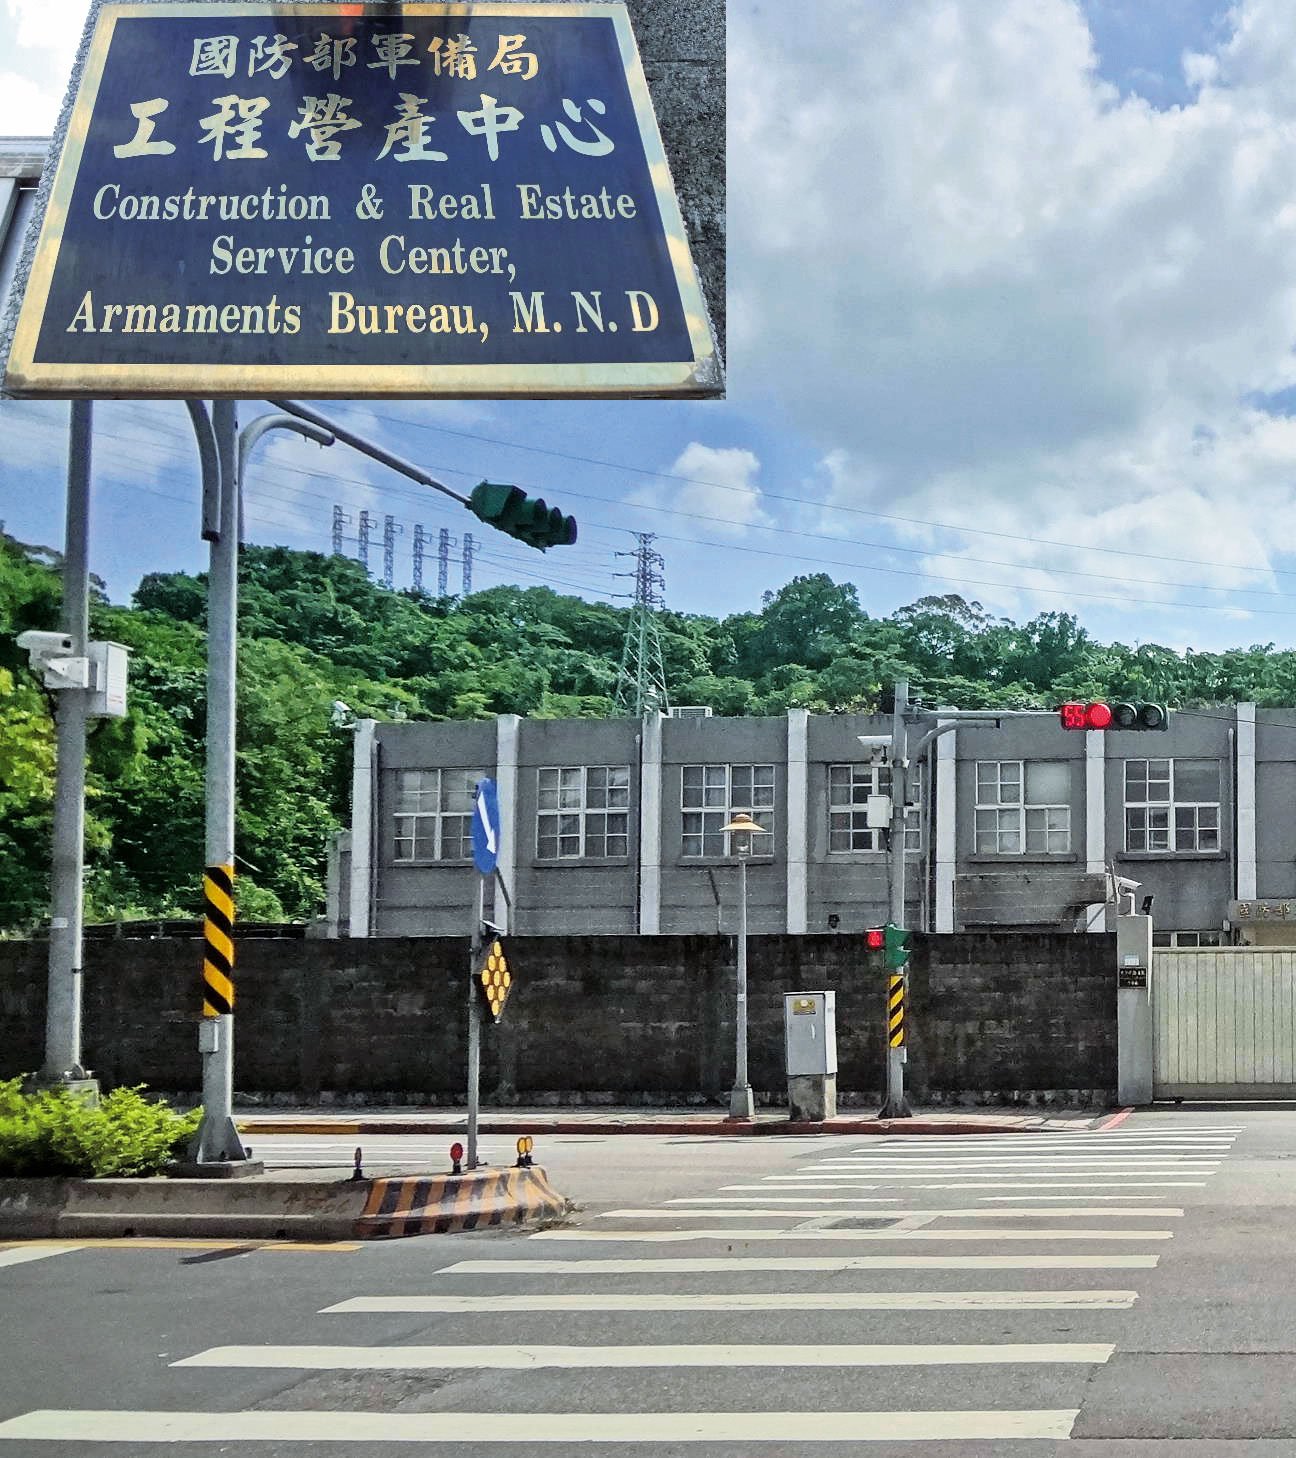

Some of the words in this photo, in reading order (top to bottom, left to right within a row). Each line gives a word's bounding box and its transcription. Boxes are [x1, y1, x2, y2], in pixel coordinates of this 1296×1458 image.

[189, 33, 539, 81] 國防部軍備局
[114, 93, 615, 163] 工程營產中心
[94, 184, 331, 221] Construction
[356, 184, 384, 220] &
[408, 184, 496, 220] Real
[516, 184, 637, 220] Estate
[210, 235, 355, 275] Service
[380, 235, 516, 284] Center,
[66, 291, 301, 335] Armaments
[328, 291, 489, 344] Bureau,
